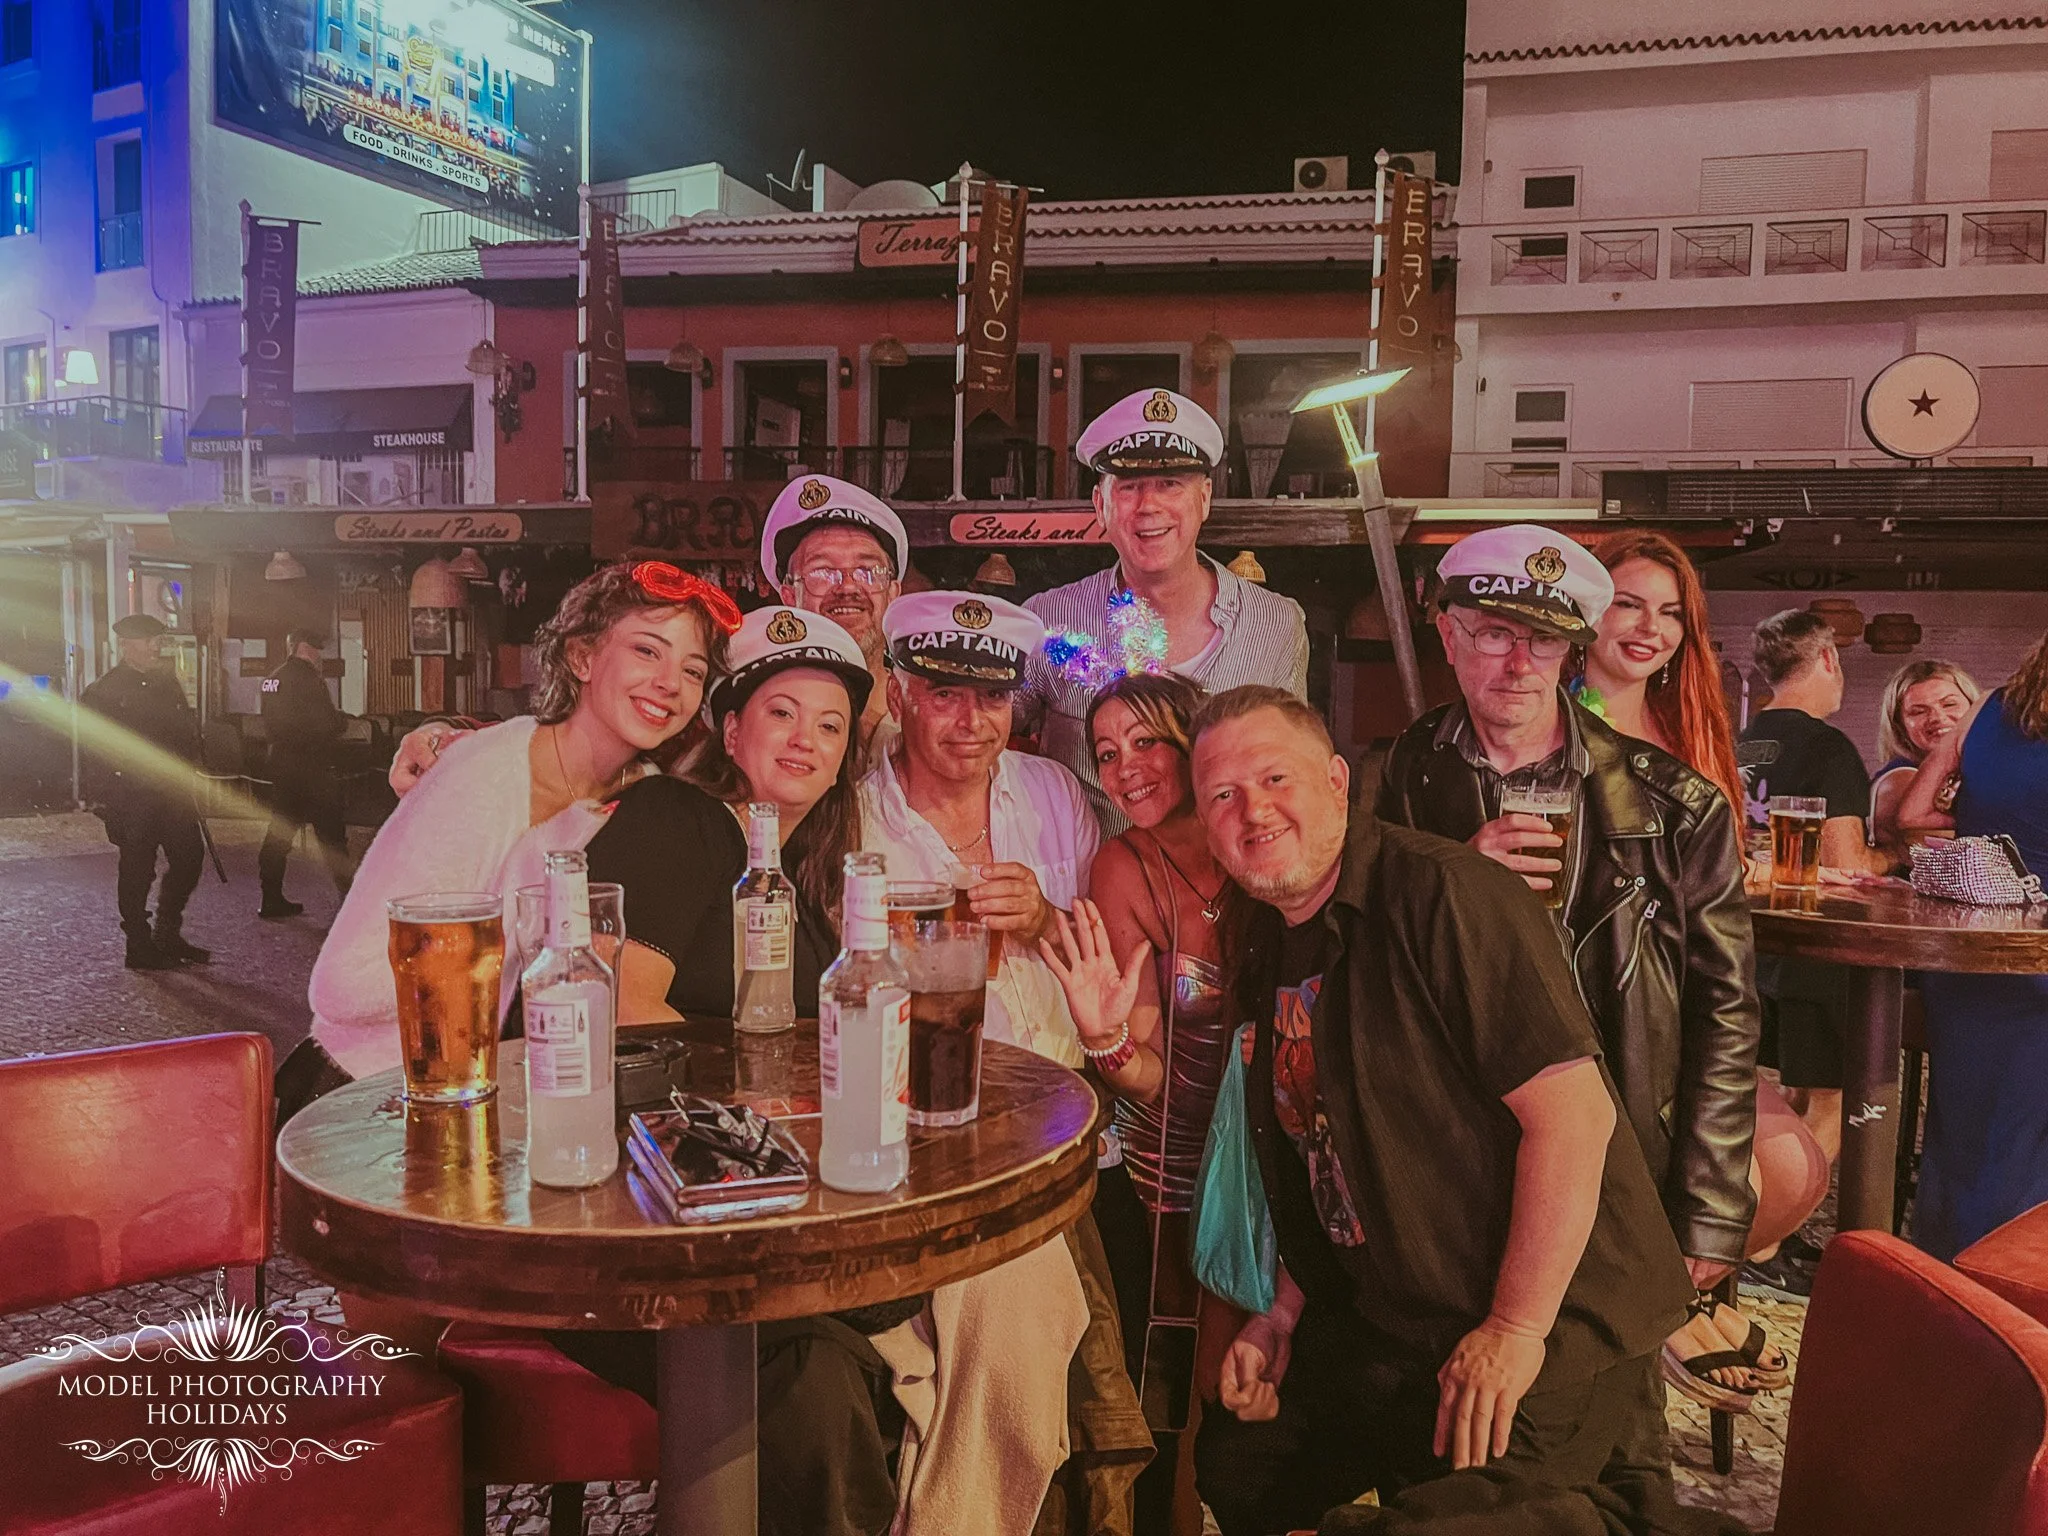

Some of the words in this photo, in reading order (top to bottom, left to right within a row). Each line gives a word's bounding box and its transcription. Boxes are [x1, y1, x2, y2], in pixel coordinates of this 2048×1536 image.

[352, 130, 384, 149] FOOD
[393, 146, 433, 169] DRINKS
[442, 164, 482, 187] SPORTS
[191, 438, 264, 453] RESTAURATE
[373, 431, 446, 448] STEAKHOUSE
[1107, 431, 1198, 458] CAPTAIN
[347, 515, 407, 540] Steaks
[408, 519, 450, 540] and
[451, 516, 511, 540] Pastas
[965, 515, 1042, 541] Steaks
[1042, 517, 1098, 541] and
[907, 630, 1020, 663] CAPTAIN
[261, 678, 280, 692] GNR
